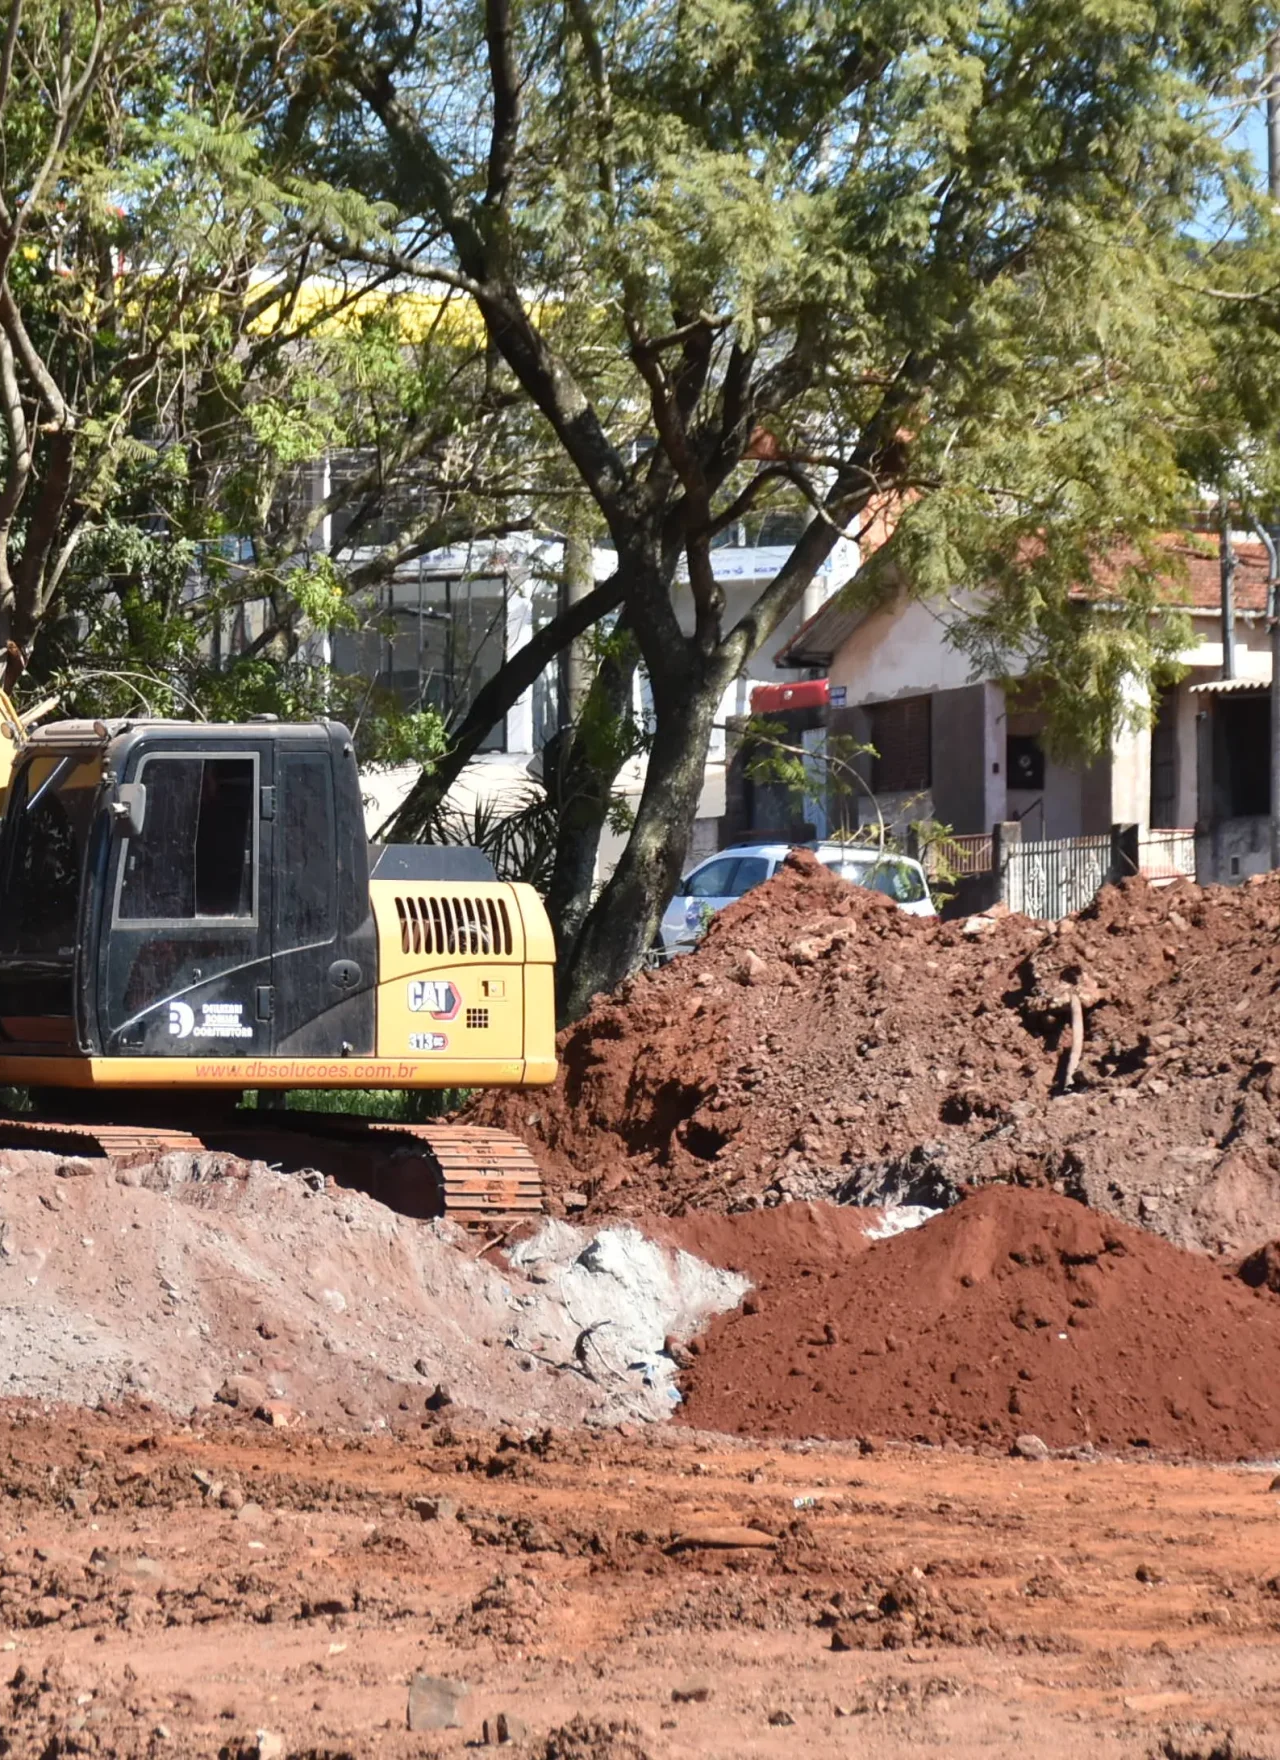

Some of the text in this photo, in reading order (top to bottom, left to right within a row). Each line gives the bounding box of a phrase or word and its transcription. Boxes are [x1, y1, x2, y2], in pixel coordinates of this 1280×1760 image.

[407, 981, 449, 1013] CAT
[408, 1033, 433, 1050] 313
[195, 1061, 418, 1079] www.dbsolucoes.com.br
